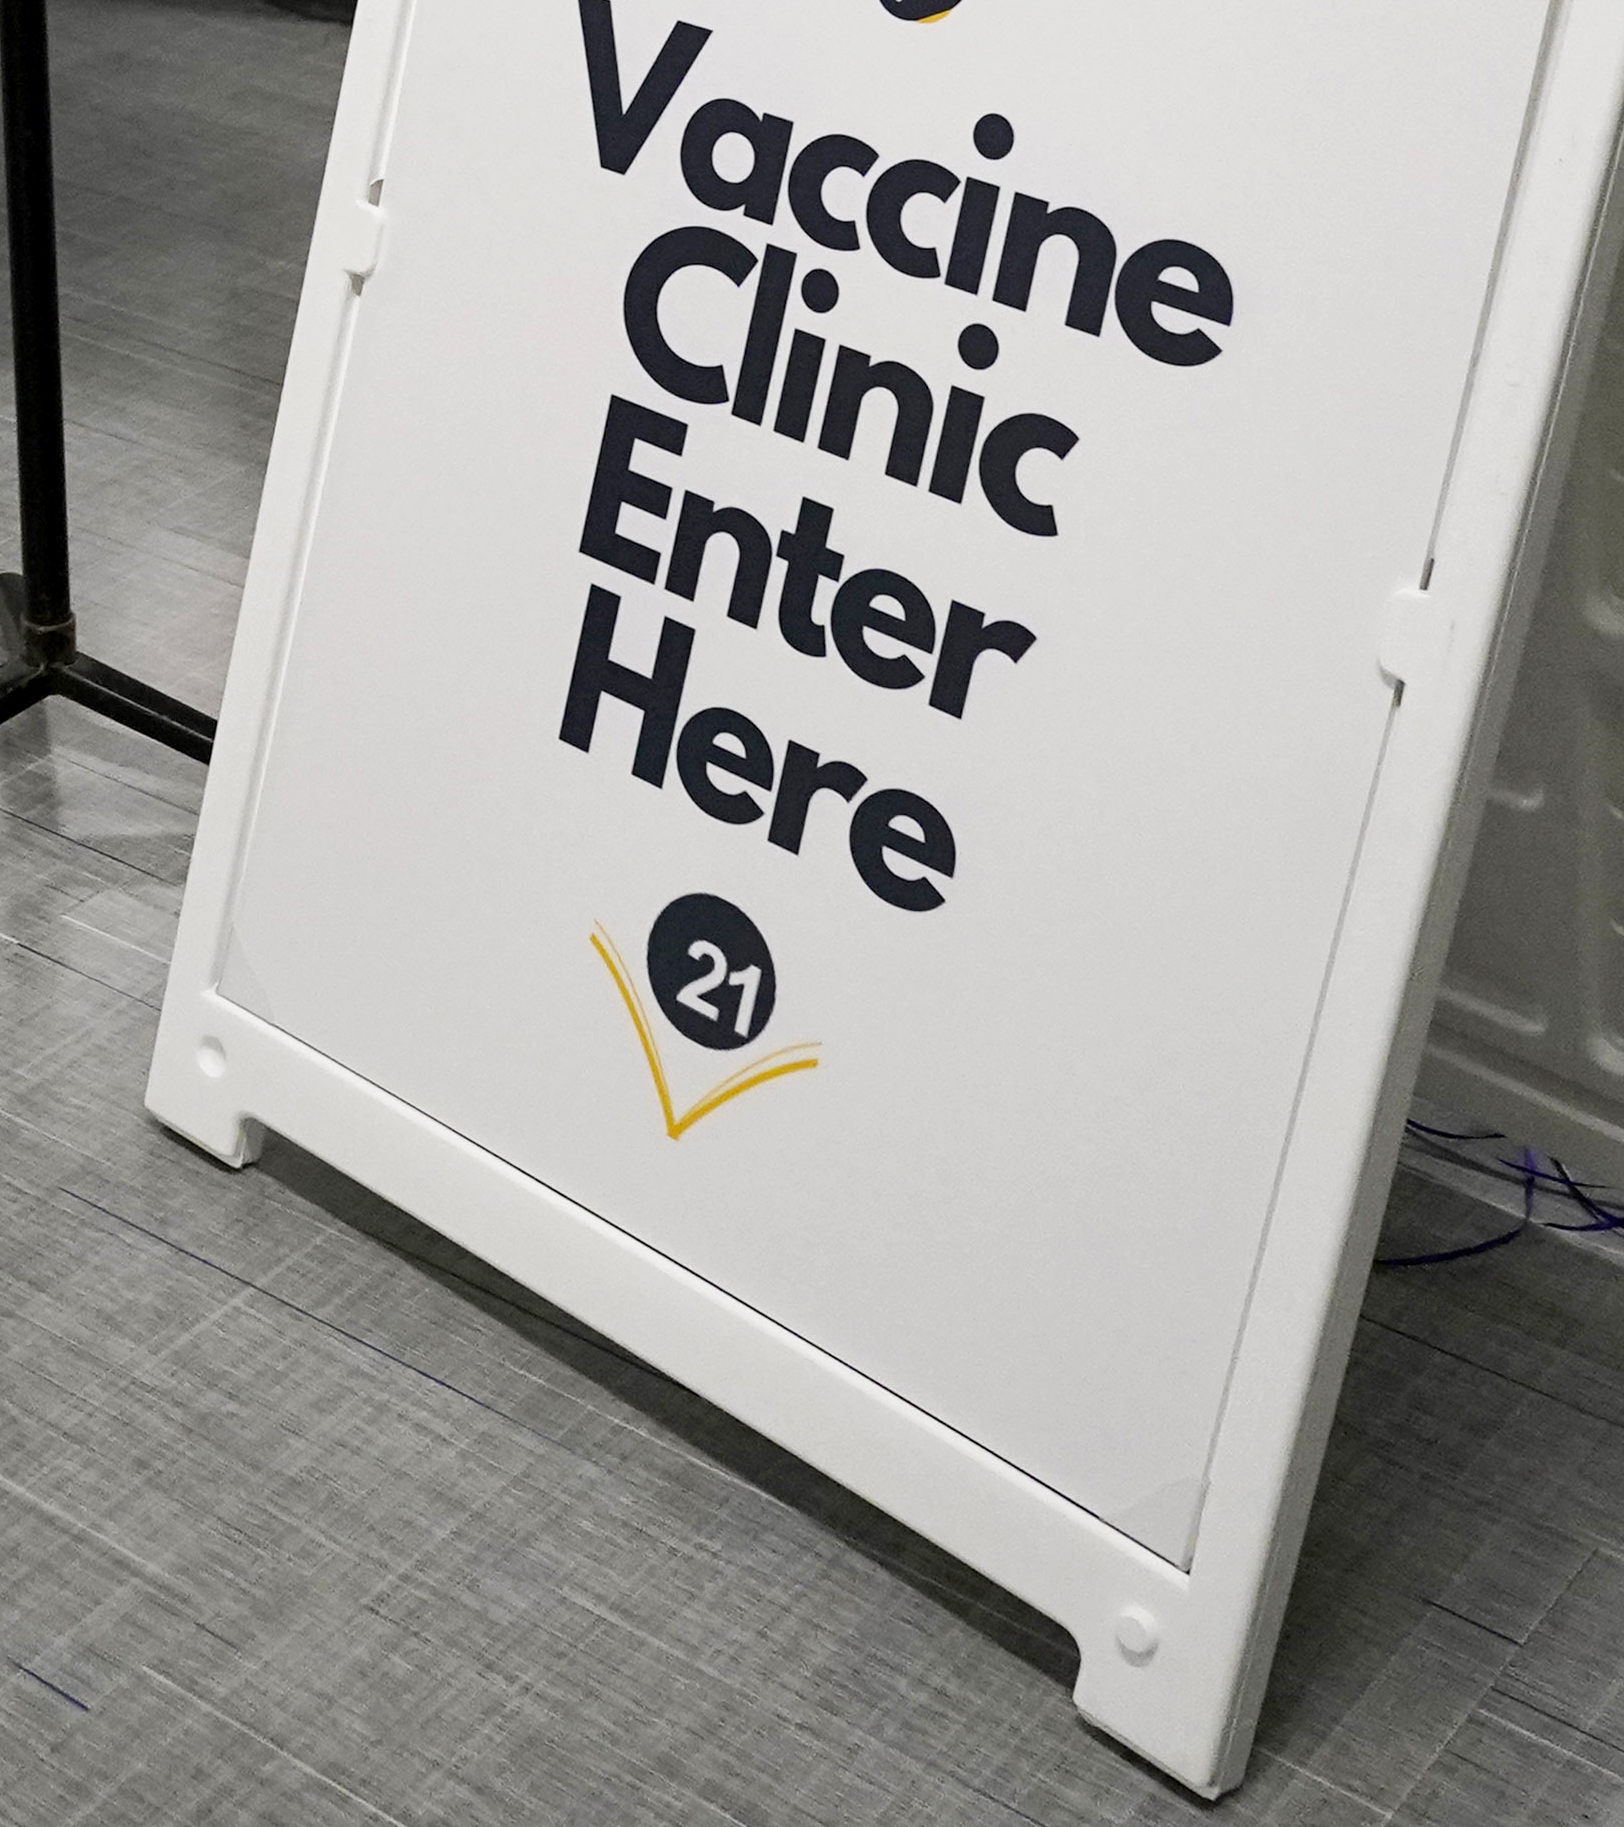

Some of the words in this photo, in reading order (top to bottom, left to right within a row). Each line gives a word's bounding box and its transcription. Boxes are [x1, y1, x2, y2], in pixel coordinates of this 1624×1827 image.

[622, 225, 1080, 537] Clinic
[578, 393, 1037, 720] Enter
[558, 582, 957, 912] Here
[675, 939, 762, 1039] 21
